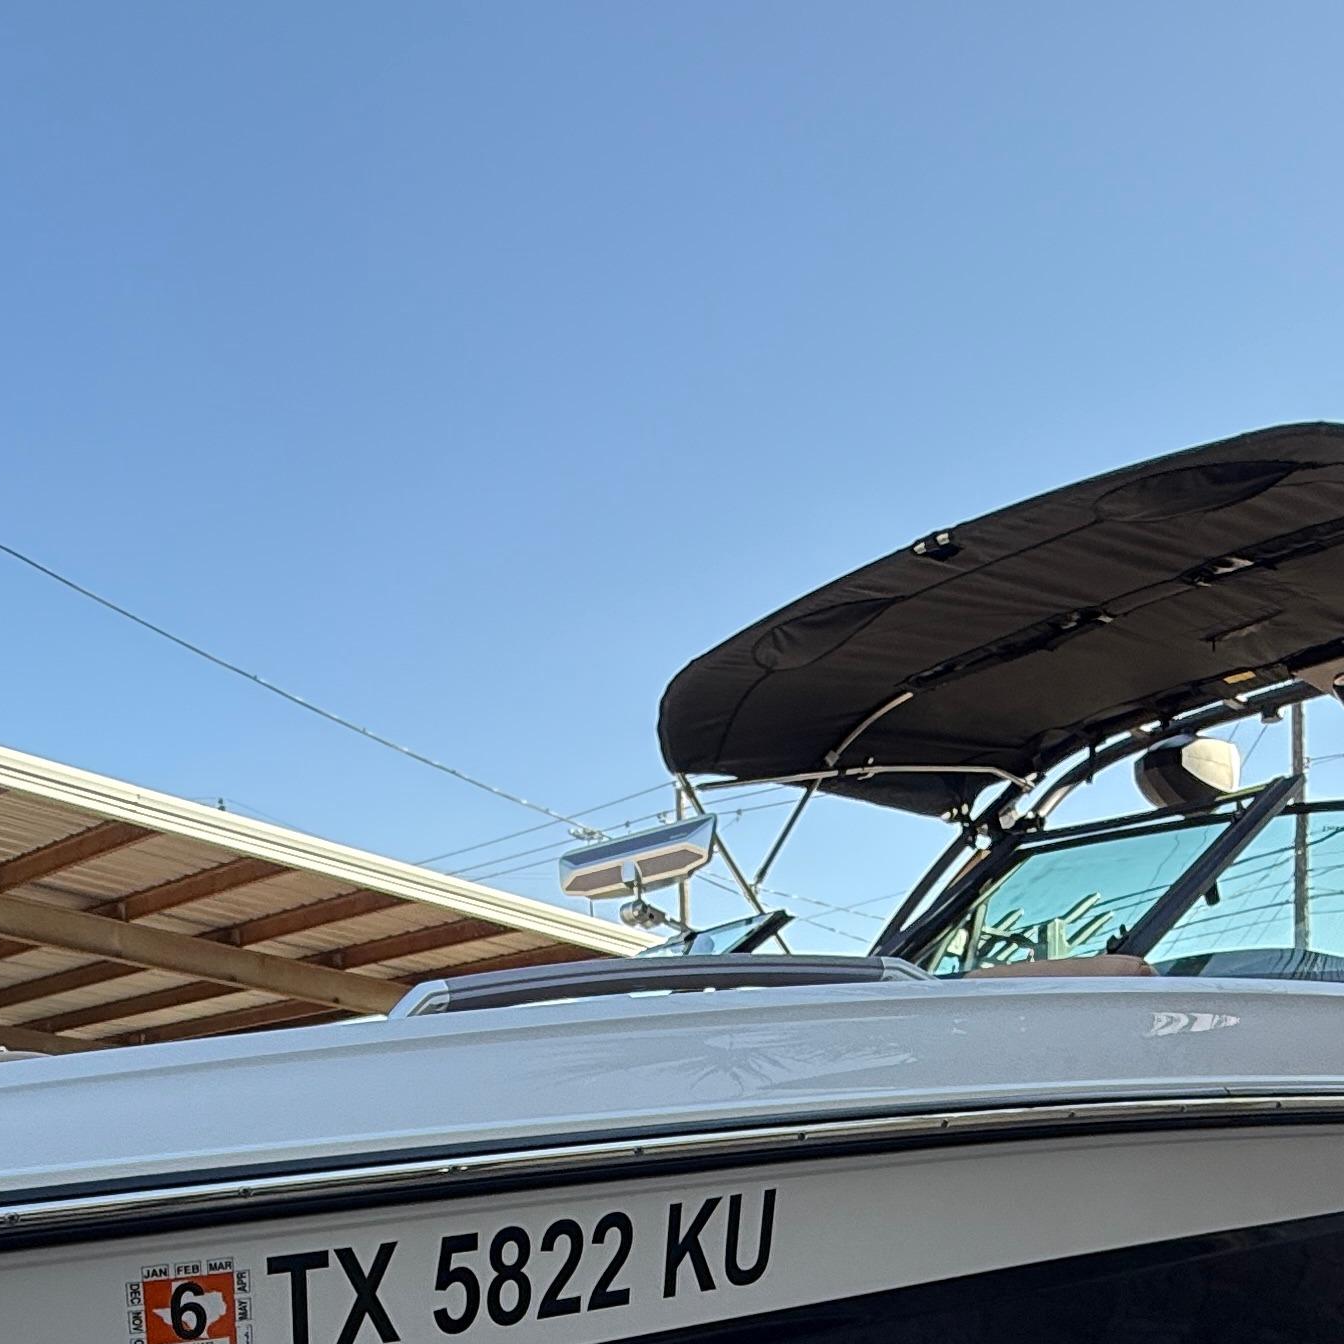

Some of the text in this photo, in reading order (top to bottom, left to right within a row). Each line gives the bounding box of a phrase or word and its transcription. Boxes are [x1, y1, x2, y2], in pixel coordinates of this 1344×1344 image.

[143, 1260, 232, 1280] JAN FEB MAR
[433, 1211, 634, 1335] 5822
[662, 1188, 777, 1299] KU
[236, 1271, 247, 1293] APR
[129, 1283, 141, 1305] DEC
[132, 1311, 144, 1332] NOV
[170, 1281, 207, 1341] 6
[238, 1300, 248, 1321] MAY
